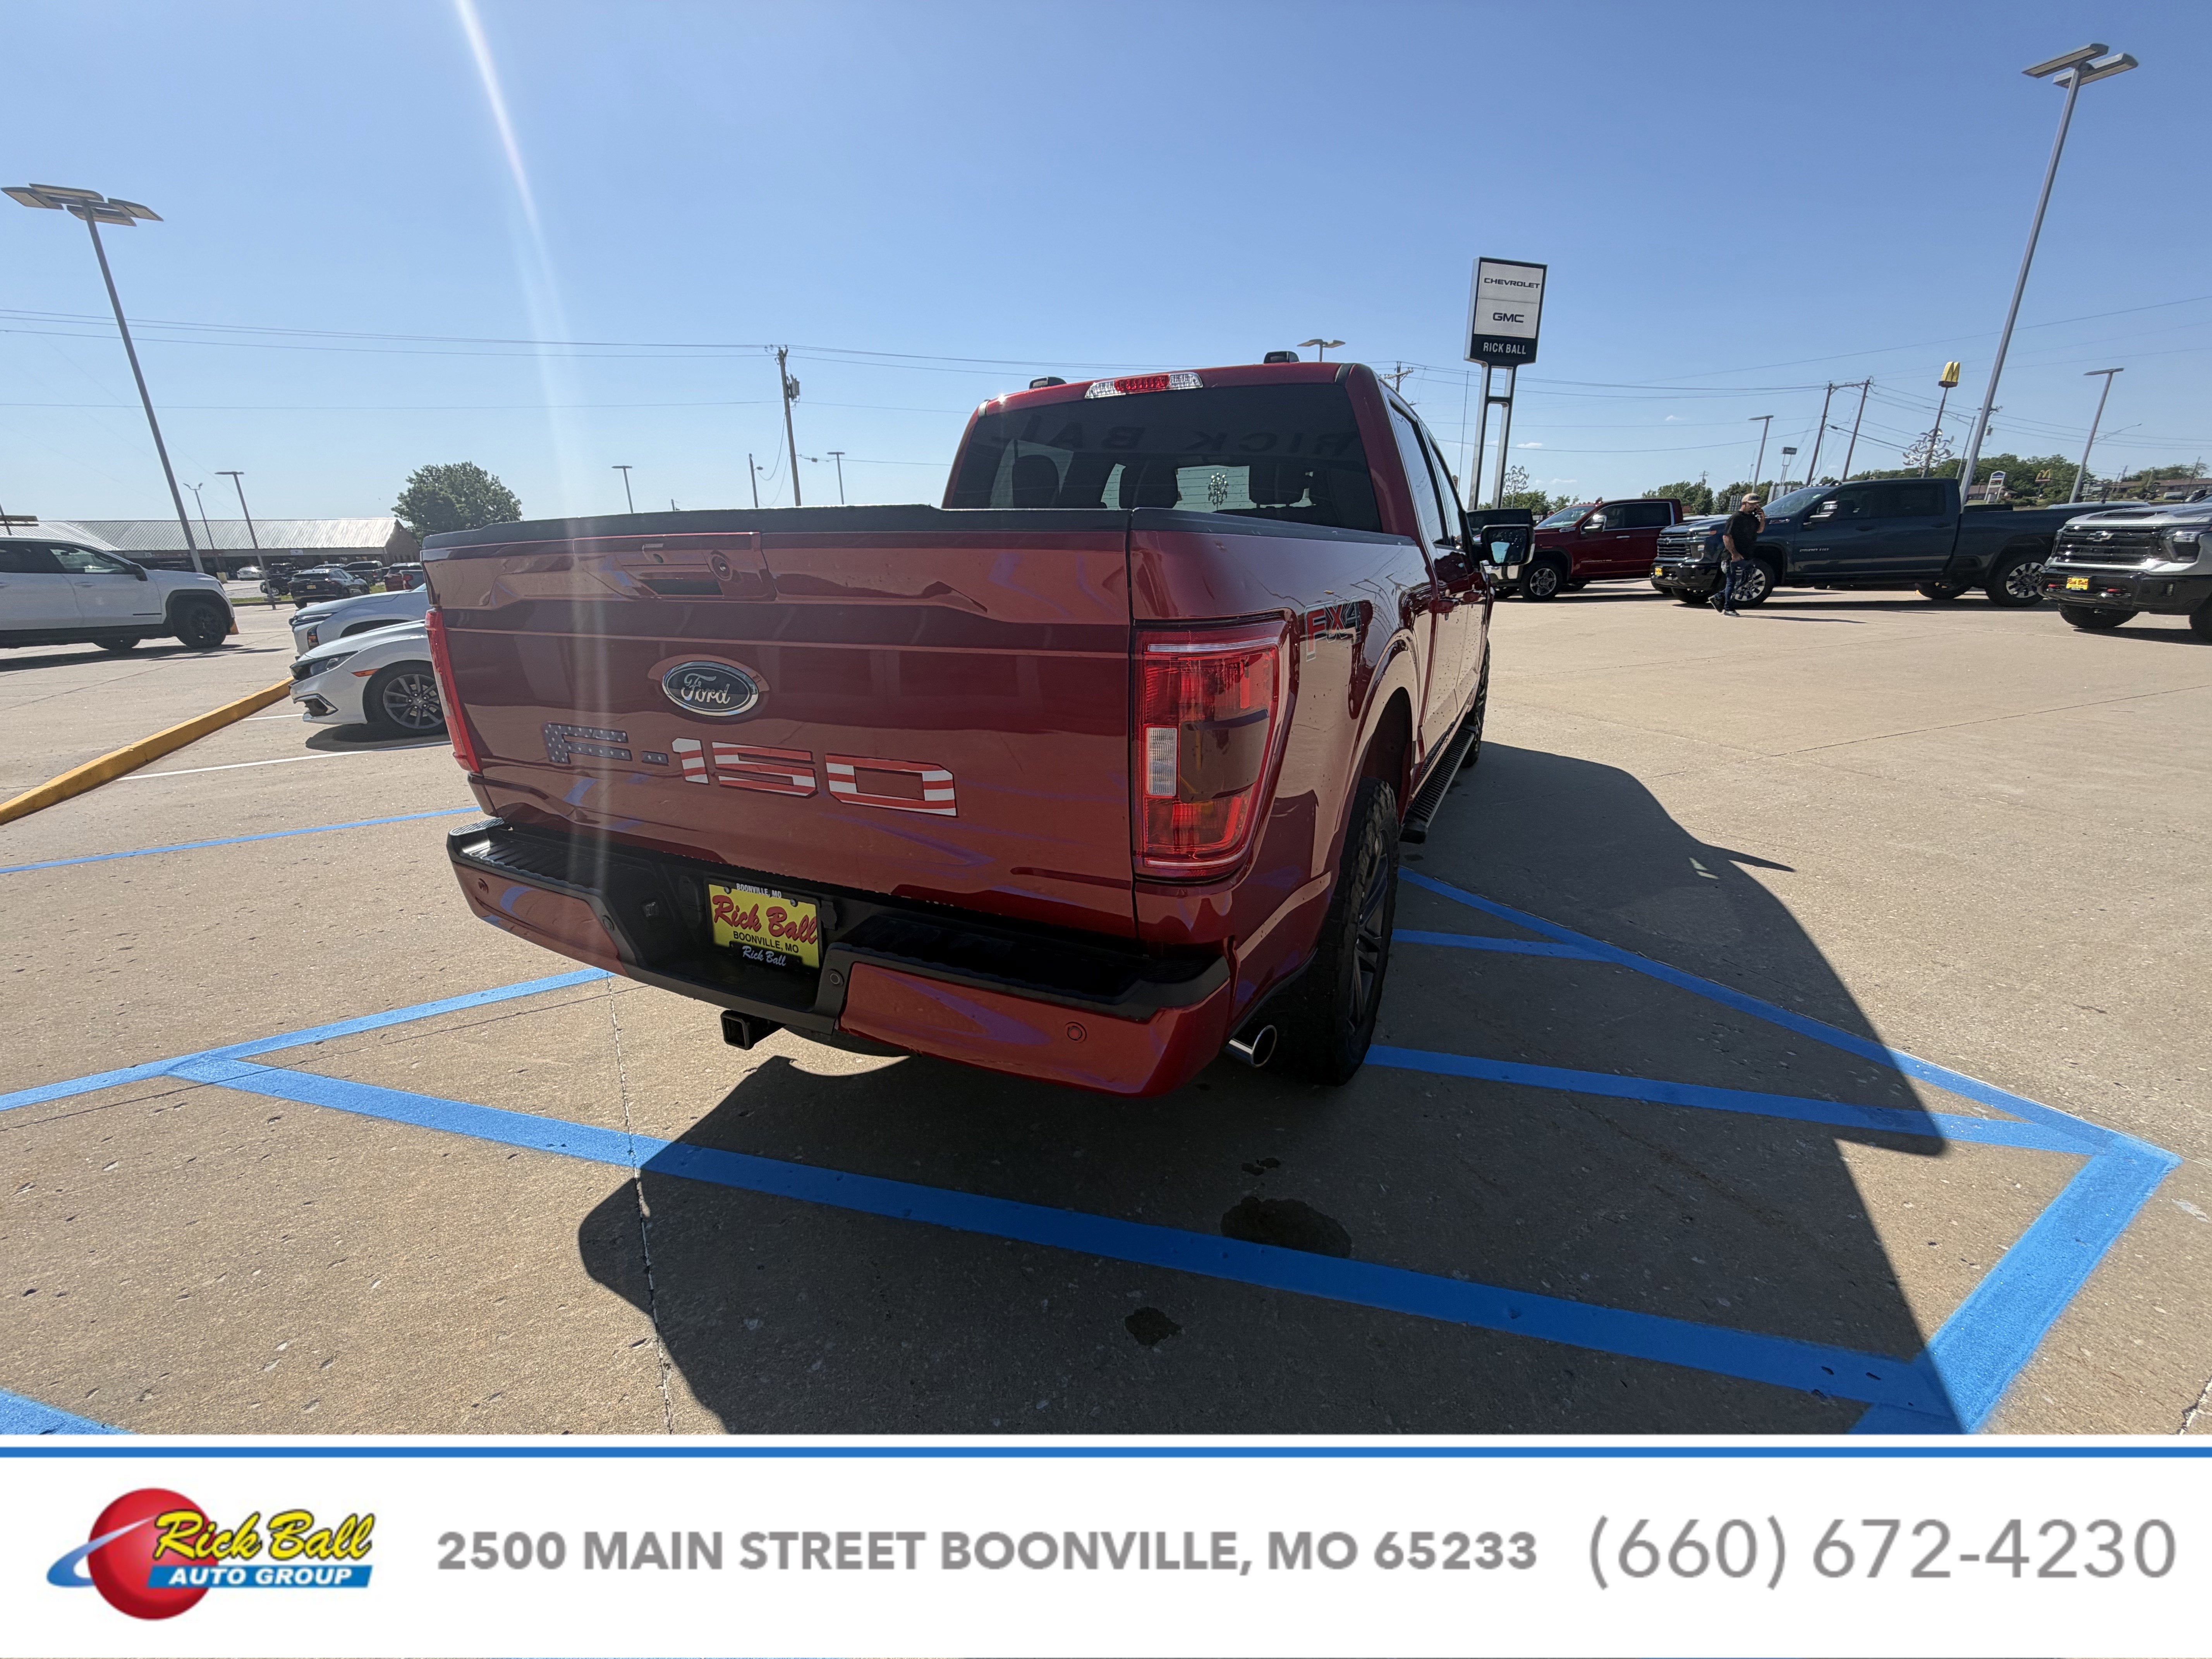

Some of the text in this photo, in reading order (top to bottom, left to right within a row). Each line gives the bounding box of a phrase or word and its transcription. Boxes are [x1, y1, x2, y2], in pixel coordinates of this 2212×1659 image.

[1484, 277, 1540, 289] CHEVROLET
[1492, 312, 1524, 323] GMC
[1483, 342, 1527, 355] RICK BALL
[1305, 598, 1362, 661] FX4
[681, 673, 730, 704] Ford
[545, 722, 957, 817] F-150
[736, 883, 782, 898] BOONVILLE, MO
[712, 895, 817, 945] Rick Ball
[733, 931, 799, 953] BOONVILLE, MO
[742, 945, 787, 966] Rick Ball
